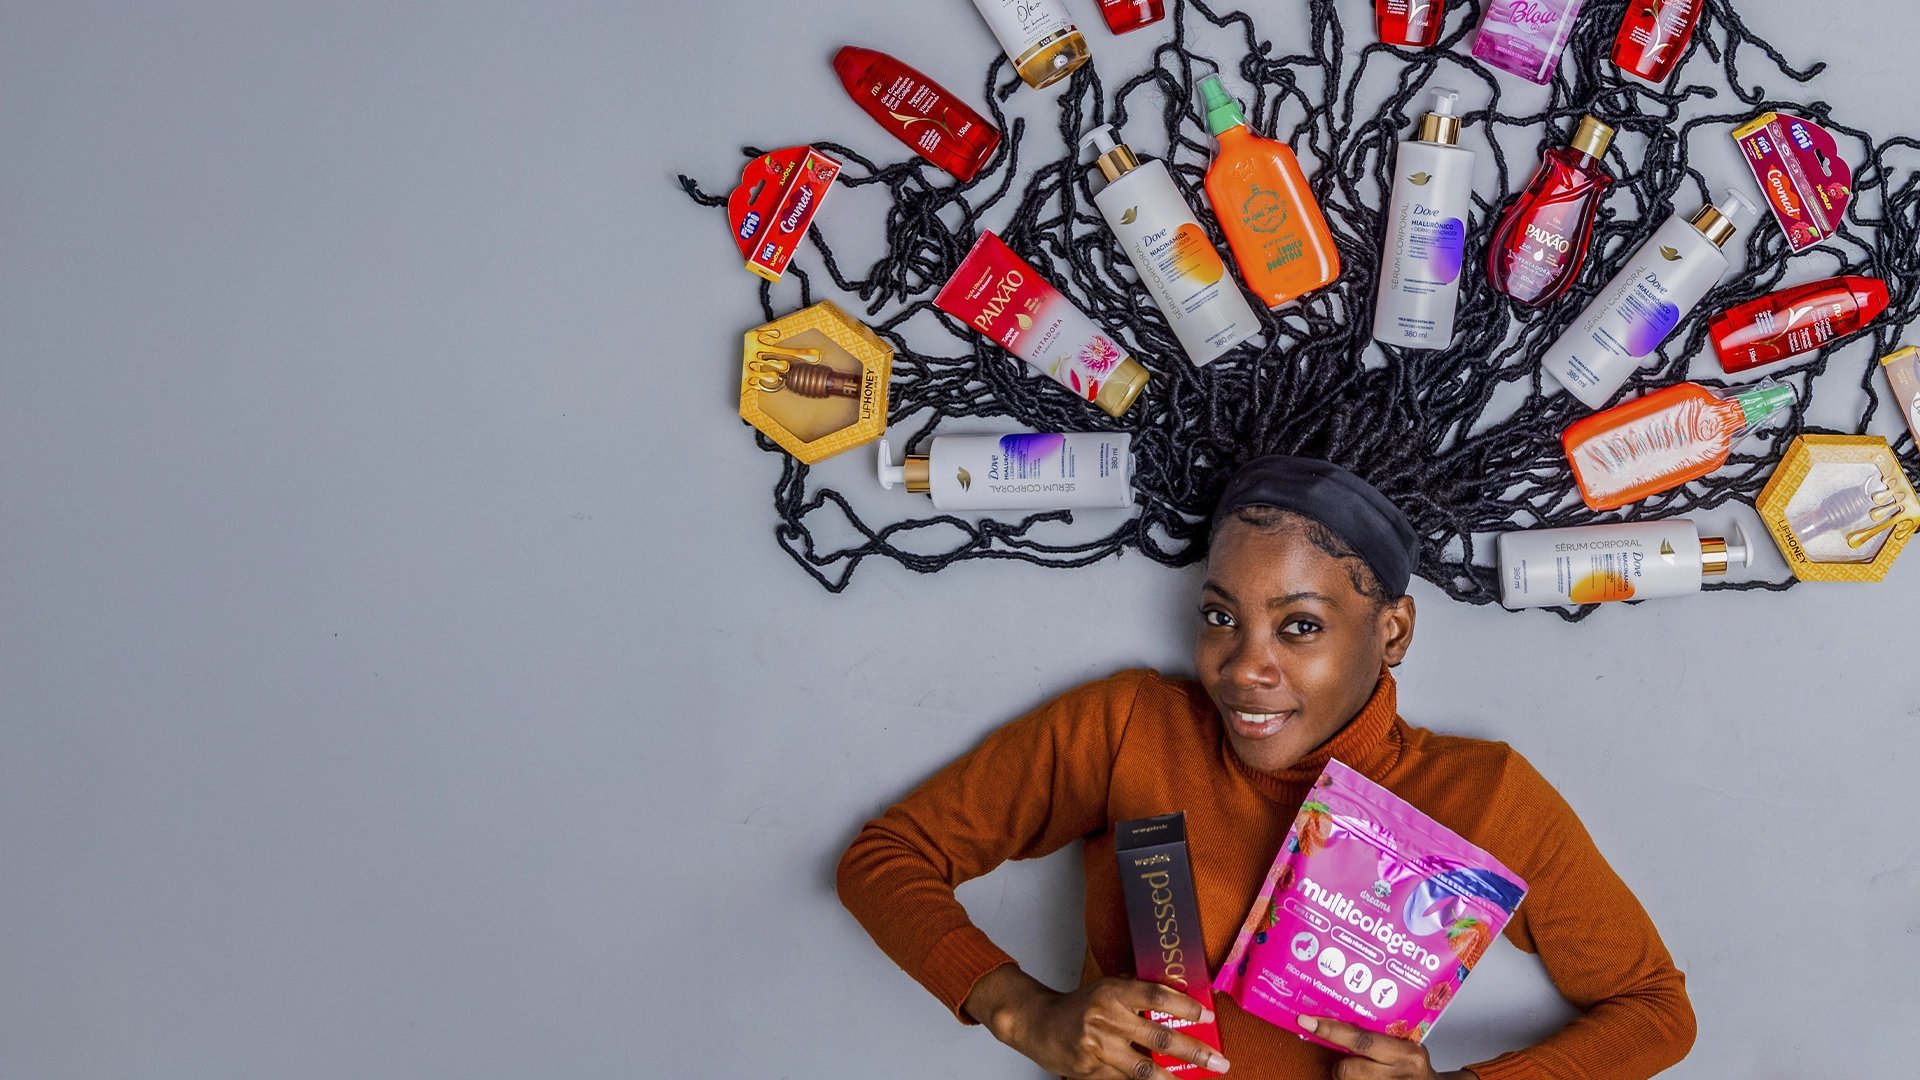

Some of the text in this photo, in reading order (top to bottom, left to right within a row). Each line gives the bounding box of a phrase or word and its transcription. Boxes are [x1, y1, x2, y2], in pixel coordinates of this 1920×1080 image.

[1508, 0, 1557, 24] Blow
[957, 121, 971, 137] 150ml
[1790, 122, 1813, 149] Fini
[1756, 135, 1772, 153] Fini
[1766, 167, 1801, 216] Carmed
[779, 185, 813, 234] Carmed
[1413, 203, 1439, 216] Dove
[737, 212, 759, 238] Fini
[1394, 201, 1409, 255] CORPORAL
[1411, 219, 1453, 229] HIALURÔNICO
[1142, 227, 1167, 246] Dove
[1149, 230, 1187, 256] NIACINAMIDA
[1525, 224, 1570, 254] PAIXÃO
[760, 242, 775, 260] Fini
[1131, 241, 1164, 289] CORPORAL
[1645, 272, 1670, 294] Dove
[973, 267, 1024, 329] PAIXÃO
[1582, 303, 1608, 331] SÉRUM
[1607, 263, 1646, 306] CORPORAL
[1637, 282, 1671, 314] HIALURÔNICO
[1001, 327, 1015, 343] Toque
[1031, 317, 1062, 357] TENTADORA
[1213, 336, 1227, 347] 380
[1403, 329, 1417, 337] 380
[1748, 347, 1757, 362] 150ml
[1566, 369, 1586, 387] 380 ml
[862, 368, 874, 419] LIPHONEY
[1111, 447, 1117, 455] ml
[988, 454, 998, 479] Dove
[989, 482, 1075, 493] SÉRUM CORPORAL
[1555, 538, 1642, 551] SÉRUM CORPORAL
[1778, 519, 1807, 565] LIPHONEY
[1633, 551, 1643, 576] Dove
[1514, 580, 1520, 589] ml
[1359, 889, 1392, 913] dreams
[1296, 874, 1442, 971] multicolágeno
[1285, 962, 1300, 976] Rico
[1311, 978, 1342, 1001] Vitamina
